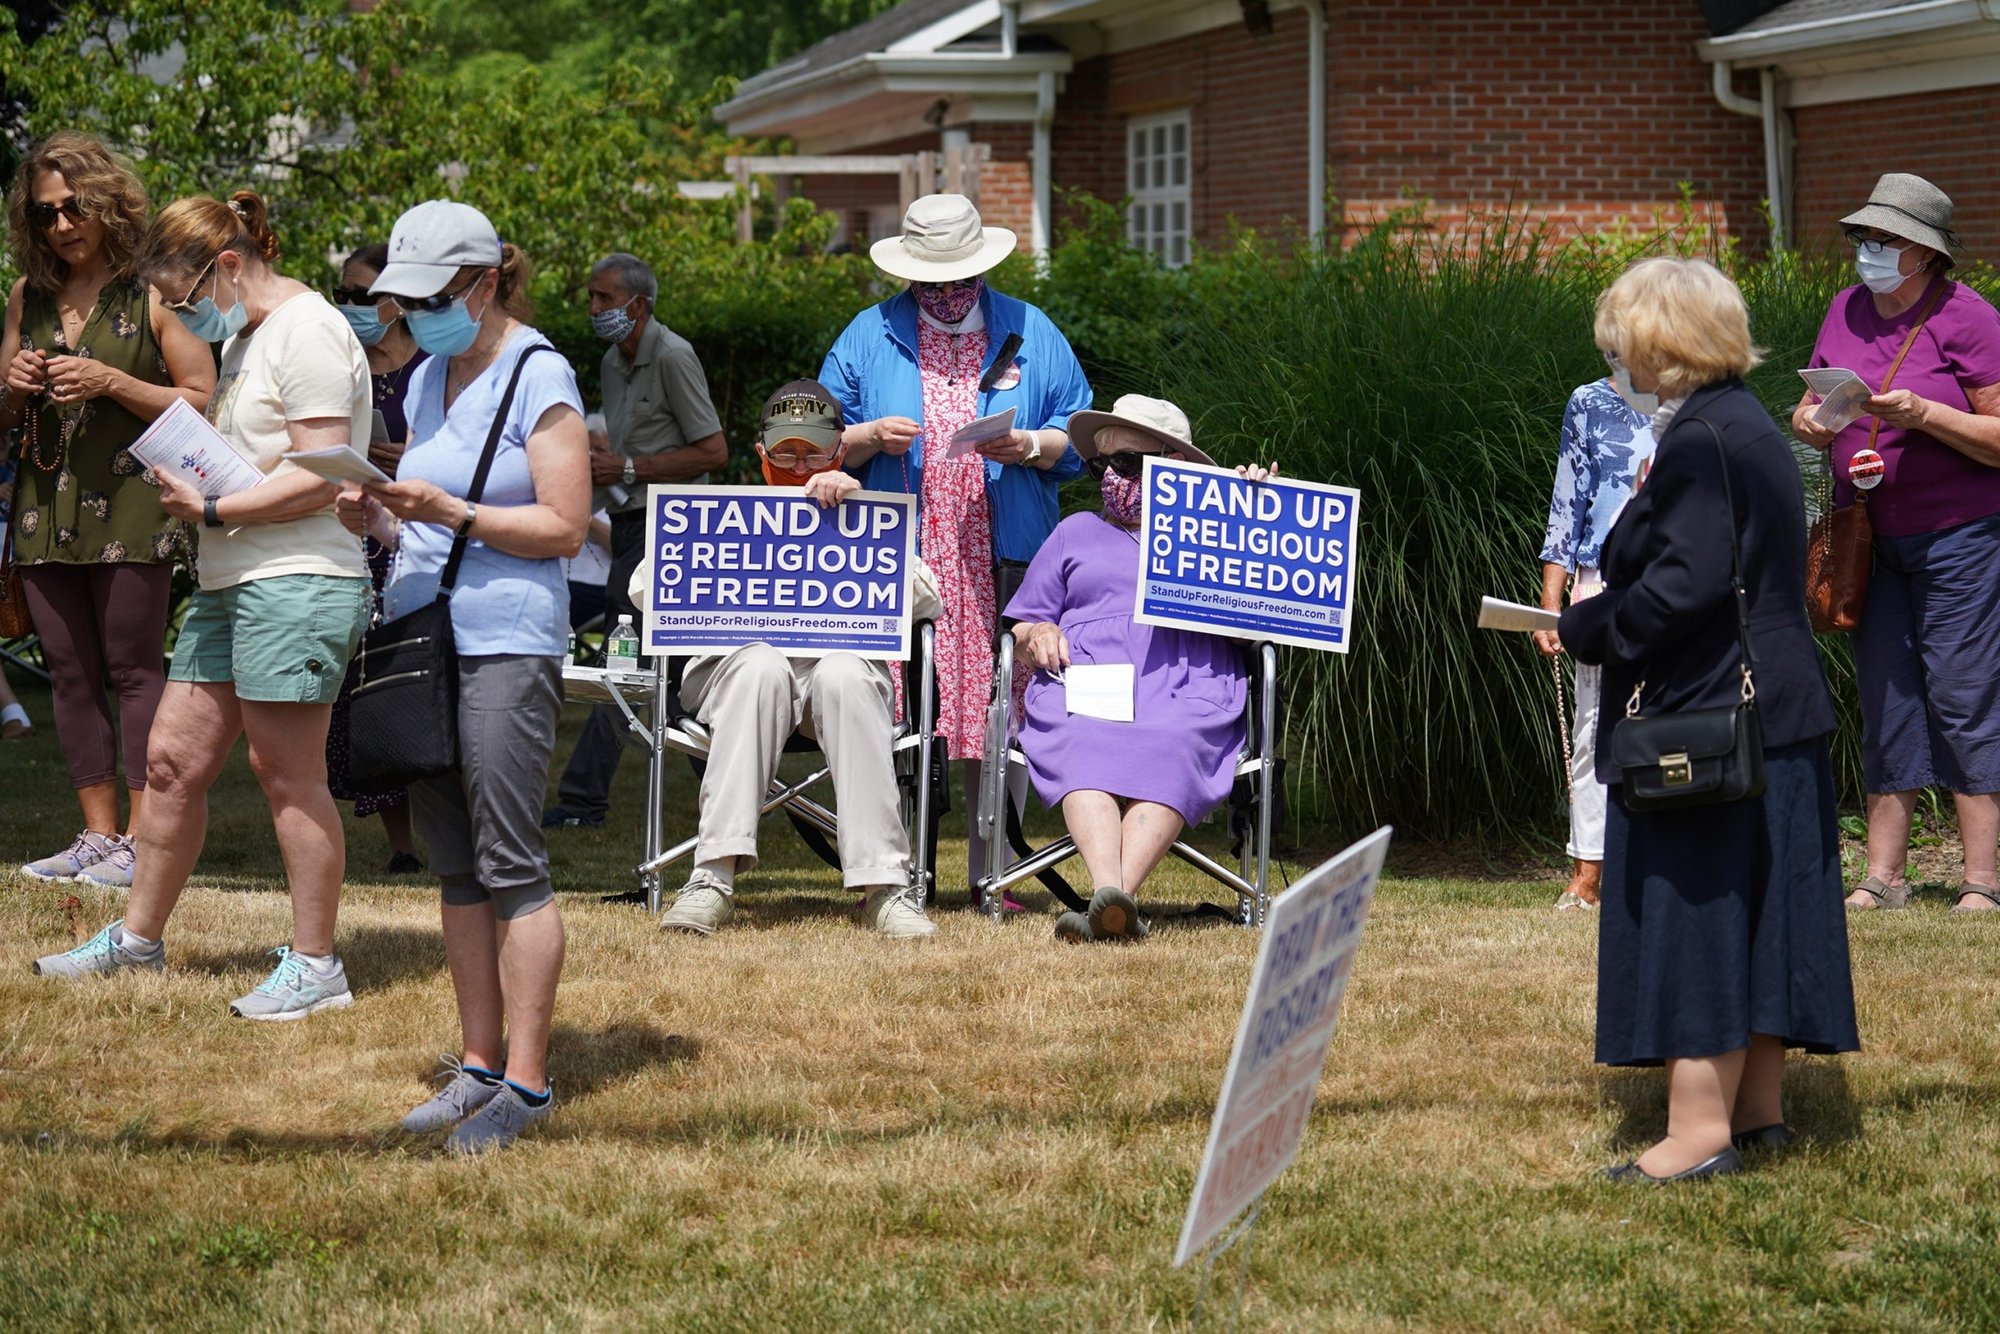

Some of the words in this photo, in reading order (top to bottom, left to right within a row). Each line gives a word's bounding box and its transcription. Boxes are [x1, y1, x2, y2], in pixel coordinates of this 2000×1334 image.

[770, 398, 829, 417] ARMY
[662, 499, 821, 537] STAND
[837, 503, 900, 540] UP
[1154, 471, 1283, 522] STAND
[1295, 493, 1346, 531] UP
[691, 542, 898, 575] RELIGIOUS
[1152, 512, 1174, 576] FOR
[1178, 515, 1344, 567] RELIGIOUS
[659, 542, 684, 604] FOR
[689, 577, 898, 610] FREEDOM
[1176, 549, 1342, 602] FREEDOM
[659, 615, 878, 630] StandUpForReligiousFreedom.com
[1151, 585, 1326, 621] StandUpForReligiousFreedom.com
